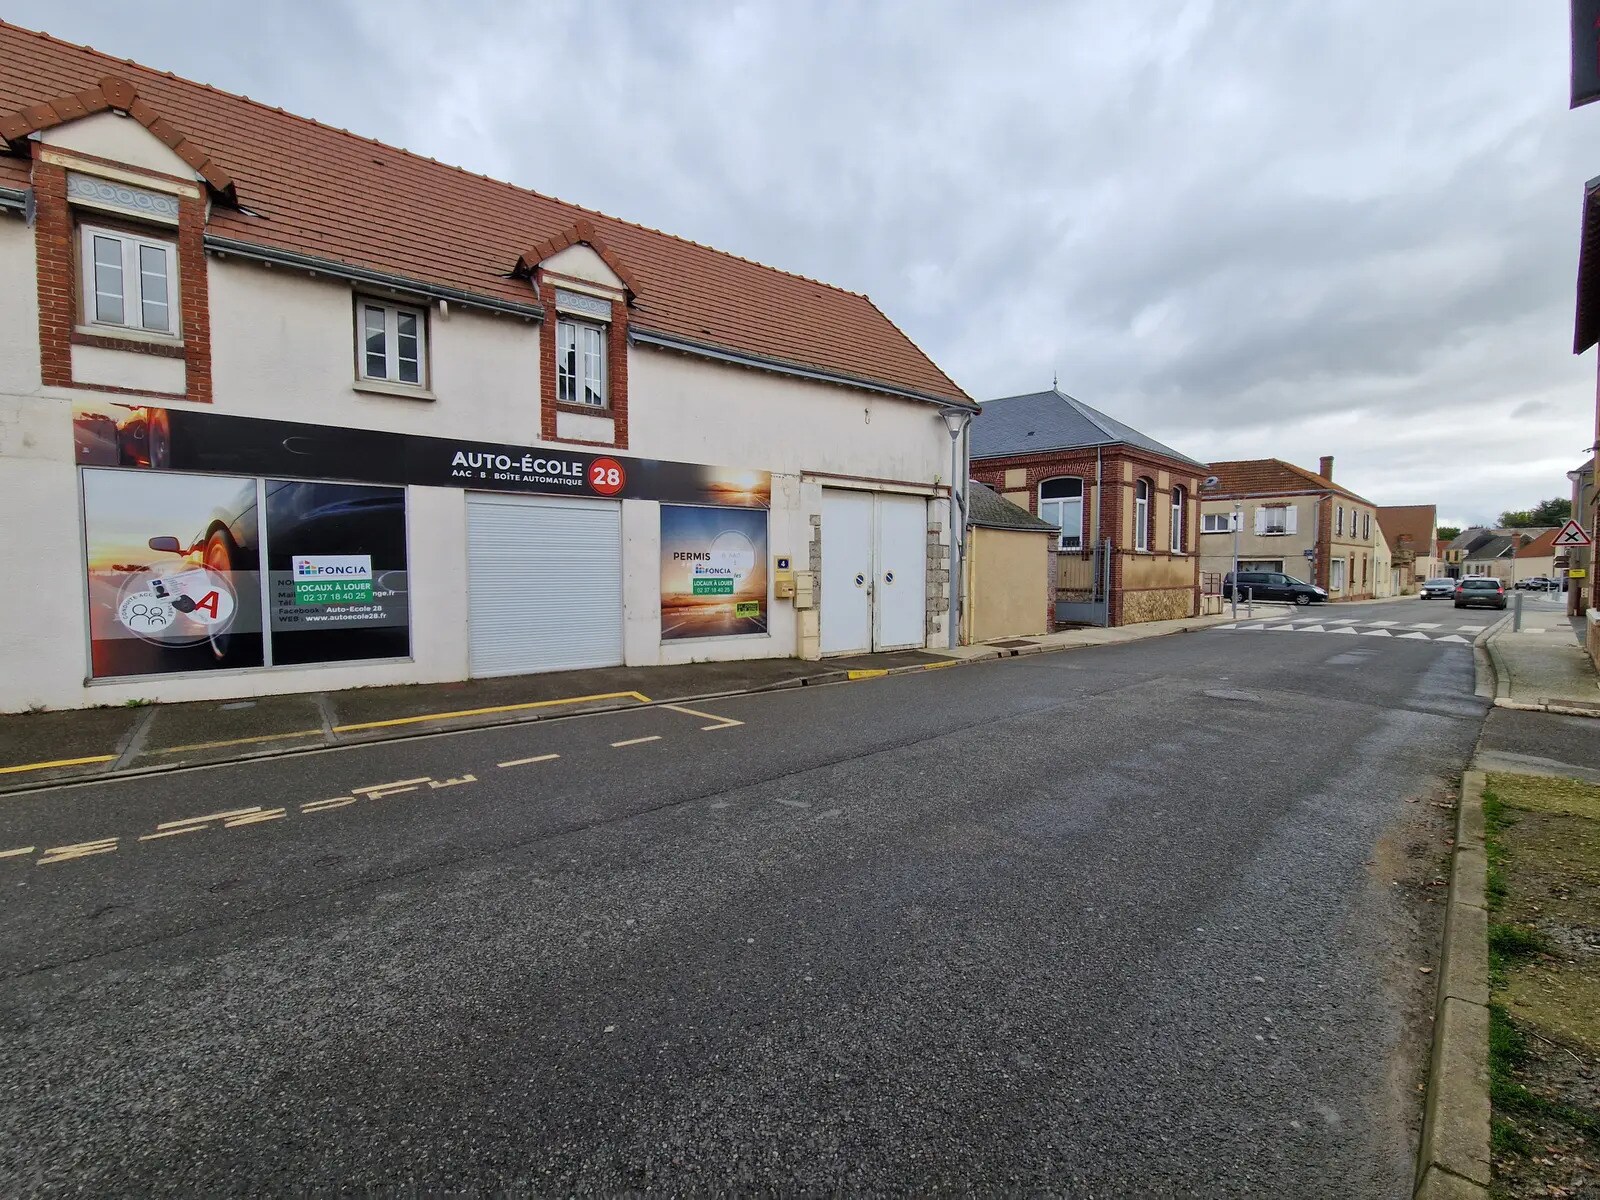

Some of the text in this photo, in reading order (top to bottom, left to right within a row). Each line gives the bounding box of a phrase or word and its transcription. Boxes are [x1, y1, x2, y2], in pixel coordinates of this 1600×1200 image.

[452, 451, 583, 477] AUTO-ÉCOLE
[452, 469, 583, 486] AAC B BOÎTE AUTOMATIQUE
[593, 467, 620, 486] 28
[673, 552, 711, 561] PERMIS
[318, 566, 366, 575] FONCIA
[296, 582, 371, 592] LOCAUX À LOUER
[303, 594, 314, 602] 02
[317, 593, 327, 601] 37
[330, 593, 341, 601] 18
[343, 592, 354, 600] 40
[355, 592, 366, 600] 25
[194, 590, 219, 619] A
[305, 613, 387, 622] www.autoecole28.fr
